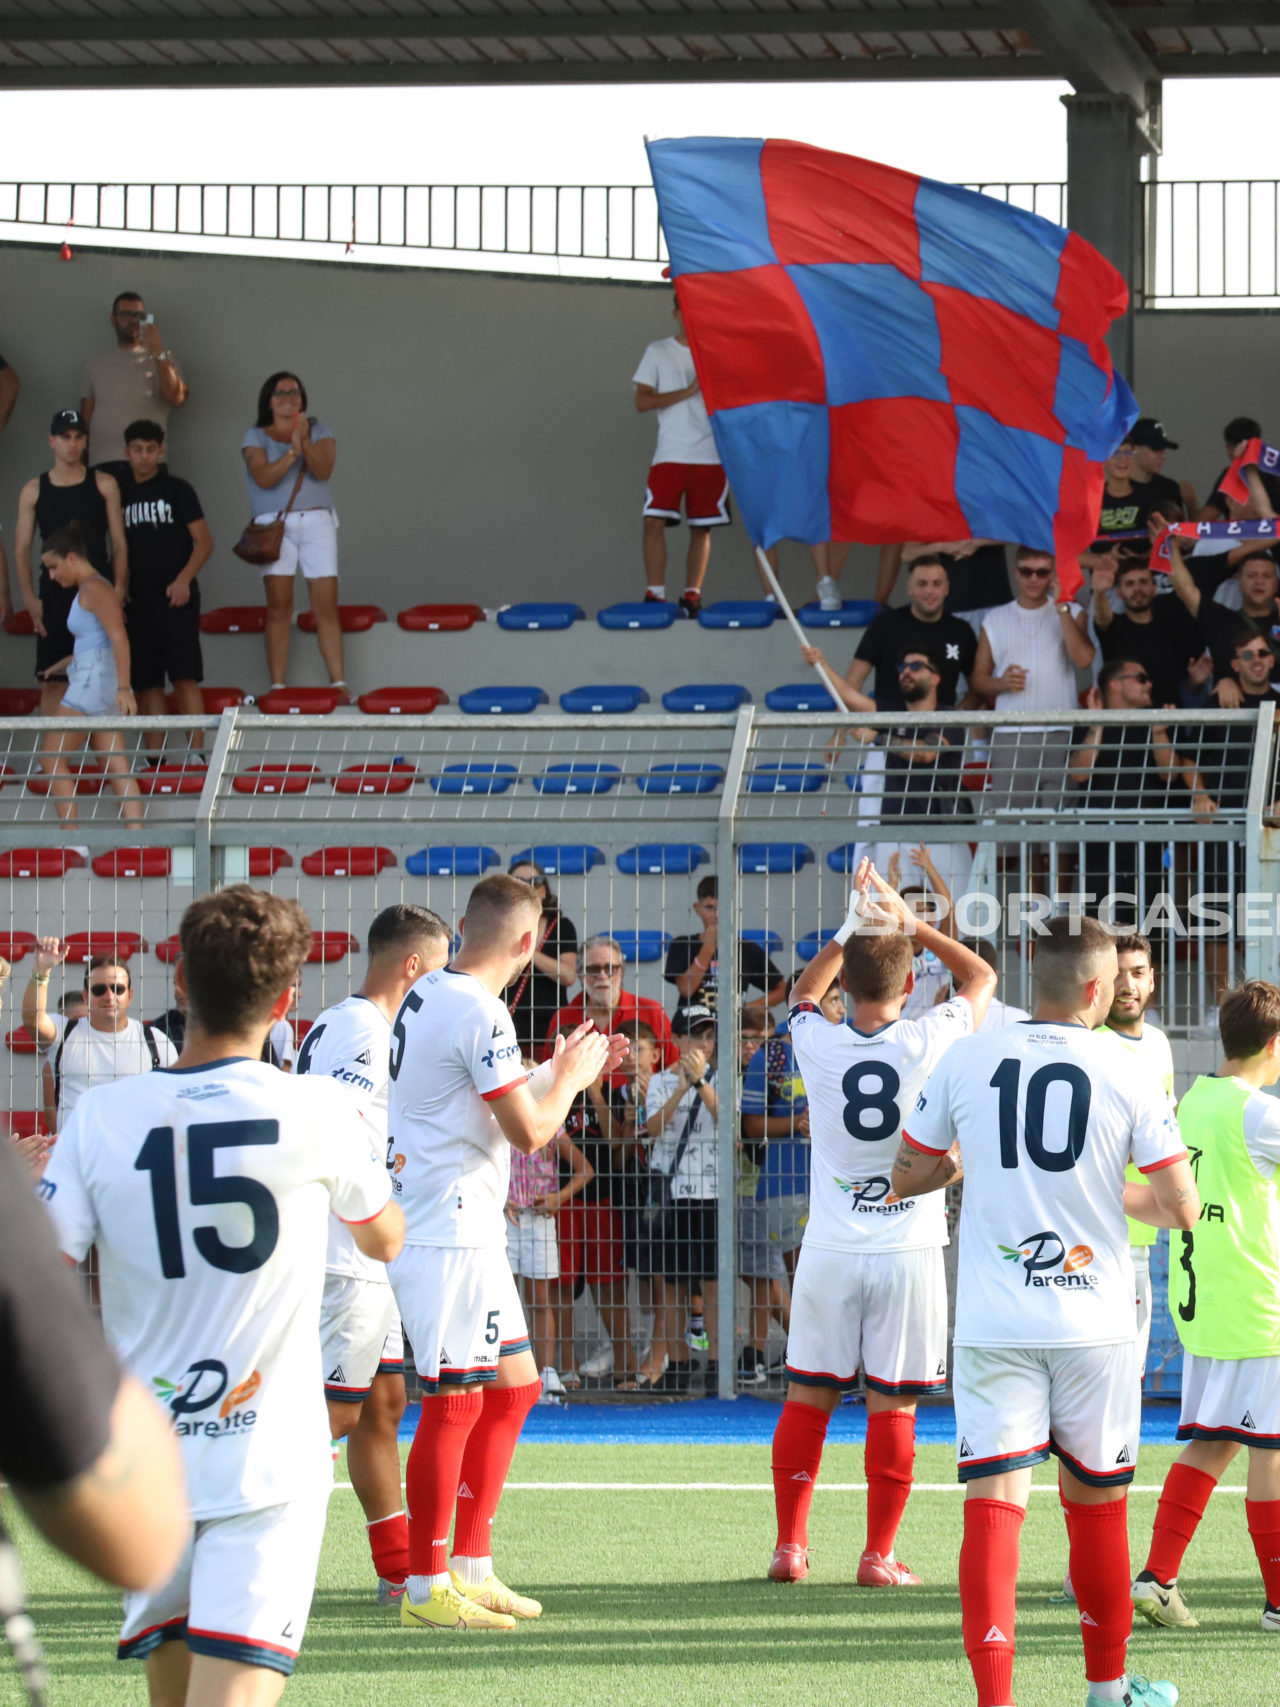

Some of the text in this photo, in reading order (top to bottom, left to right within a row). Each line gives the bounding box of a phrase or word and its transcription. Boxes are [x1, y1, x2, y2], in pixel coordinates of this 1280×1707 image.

[842, 1060, 901, 1142] 8
[990, 1058, 1091, 1172] 10
[134, 1119, 279, 1279] 15
[850, 1176, 916, 1213] Parente
[1017, 1231, 1098, 1287] Parente
[485, 1310, 500, 1344] 5
